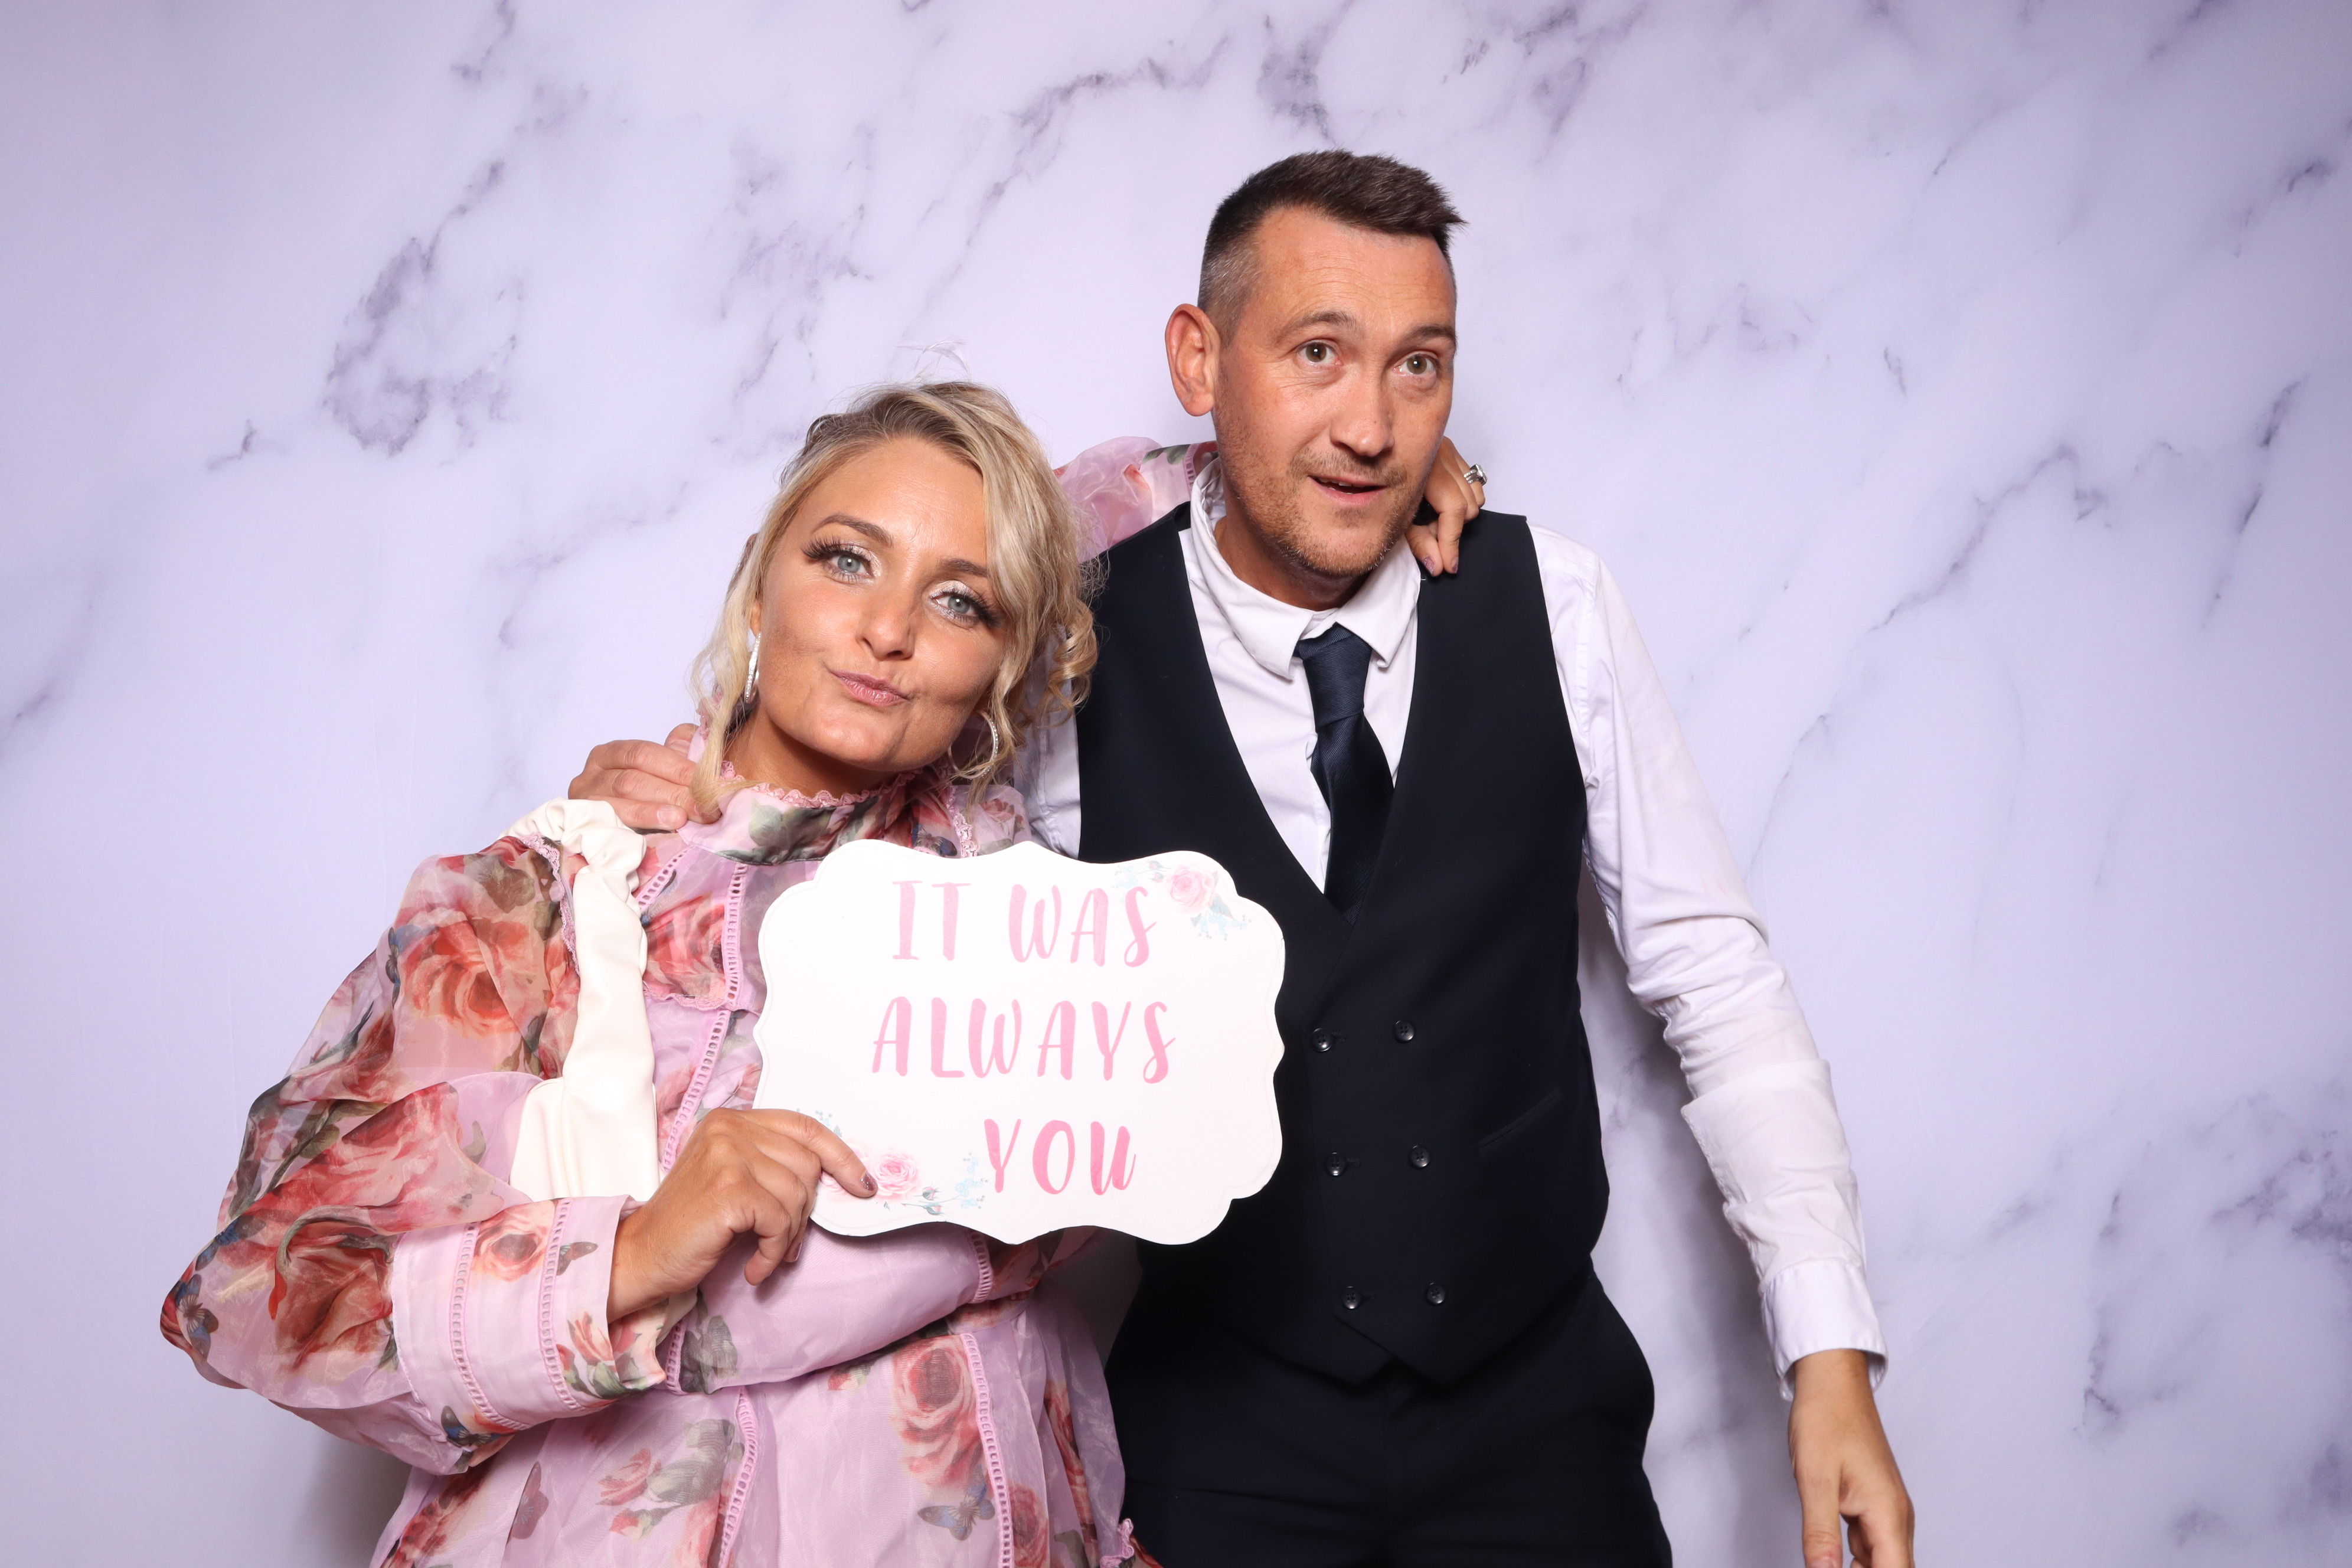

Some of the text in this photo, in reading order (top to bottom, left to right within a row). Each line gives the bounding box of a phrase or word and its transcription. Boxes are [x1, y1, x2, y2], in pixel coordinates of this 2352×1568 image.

[892, 880, 1157, 968] IT WAS
[871, 996, 1176, 1084] ALWAYS
[984, 1118, 1136, 1195] YOU
